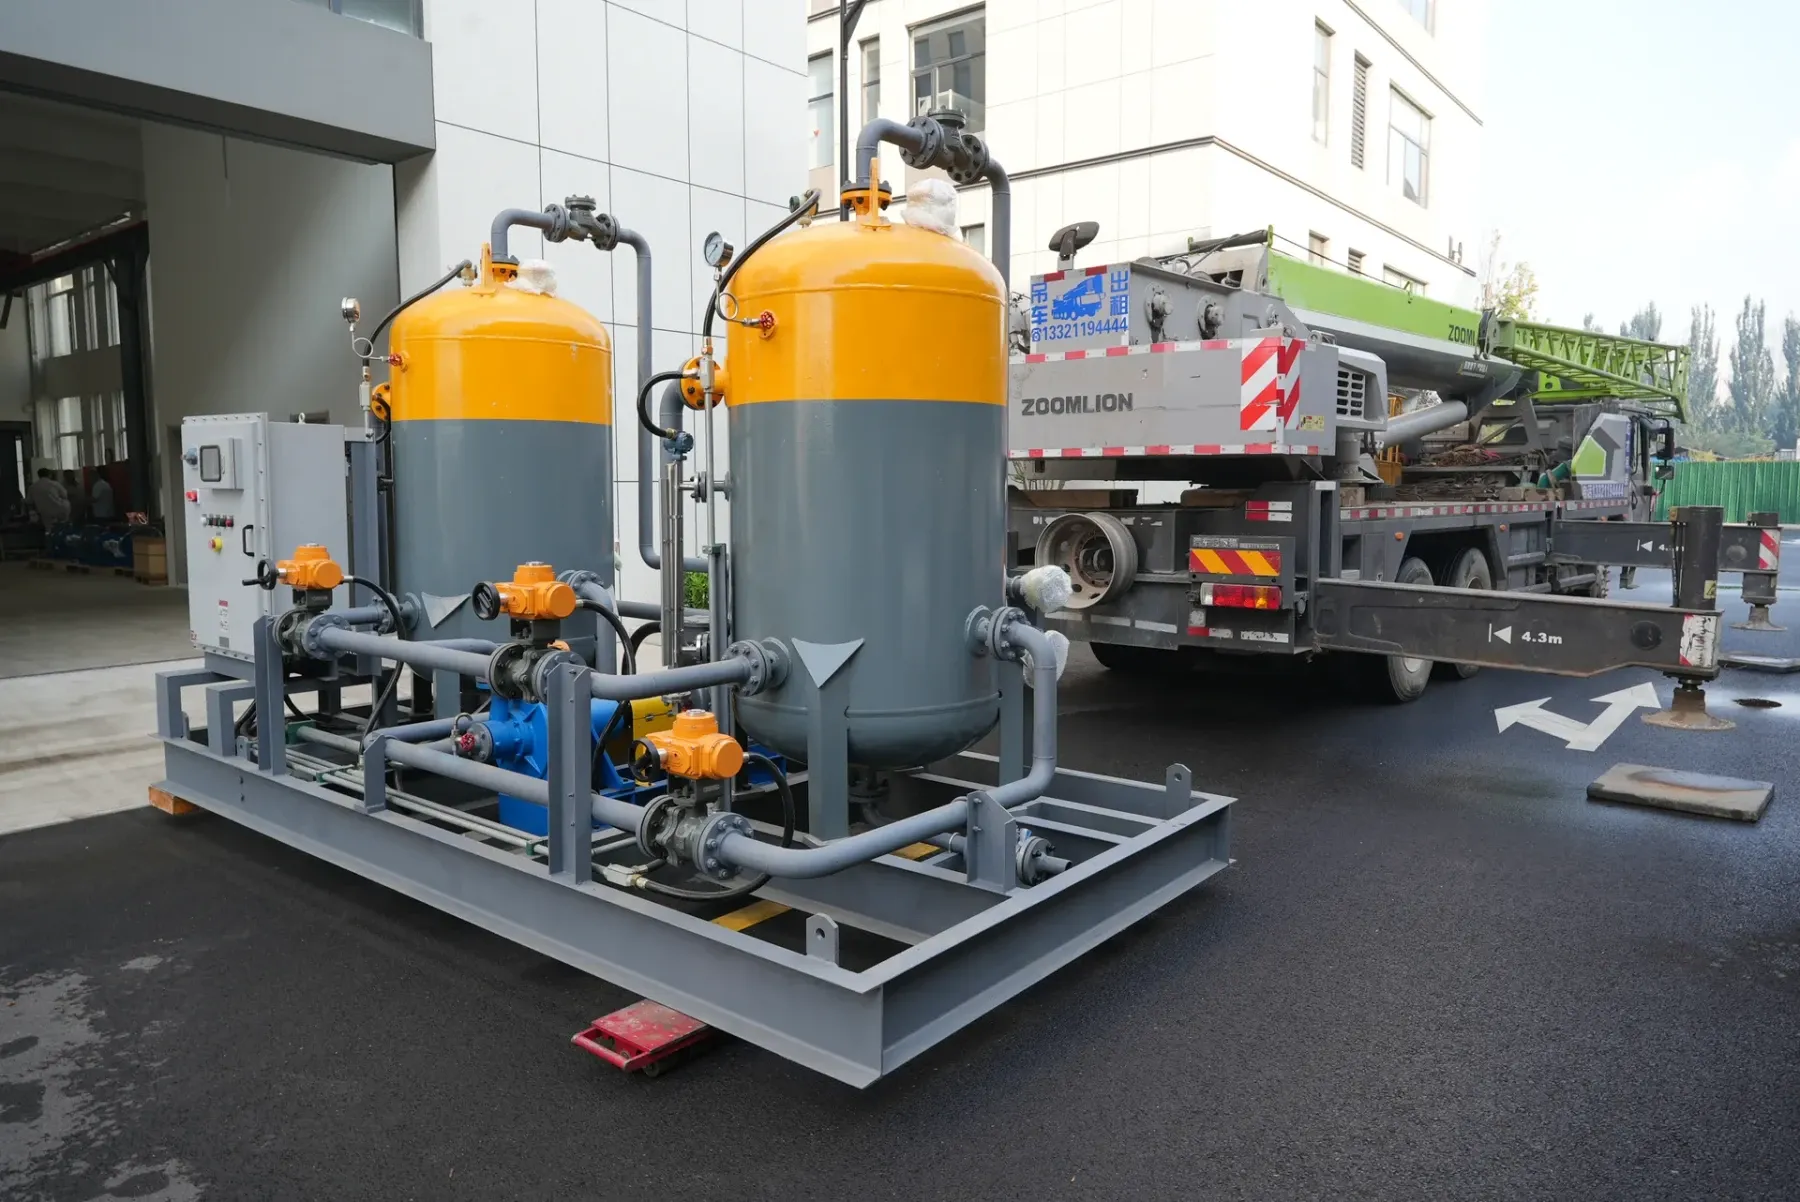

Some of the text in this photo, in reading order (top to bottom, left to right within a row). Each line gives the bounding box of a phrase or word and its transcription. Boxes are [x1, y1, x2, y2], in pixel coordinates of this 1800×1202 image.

[1031, 282, 1048, 325] 吊车
[1110, 271, 1129, 316] 出租
[1042, 317, 1128, 340] 13321194444
[1021, 393, 1133, 416] ZOOMLION
[1521, 631, 1563, 644] 4.3m
